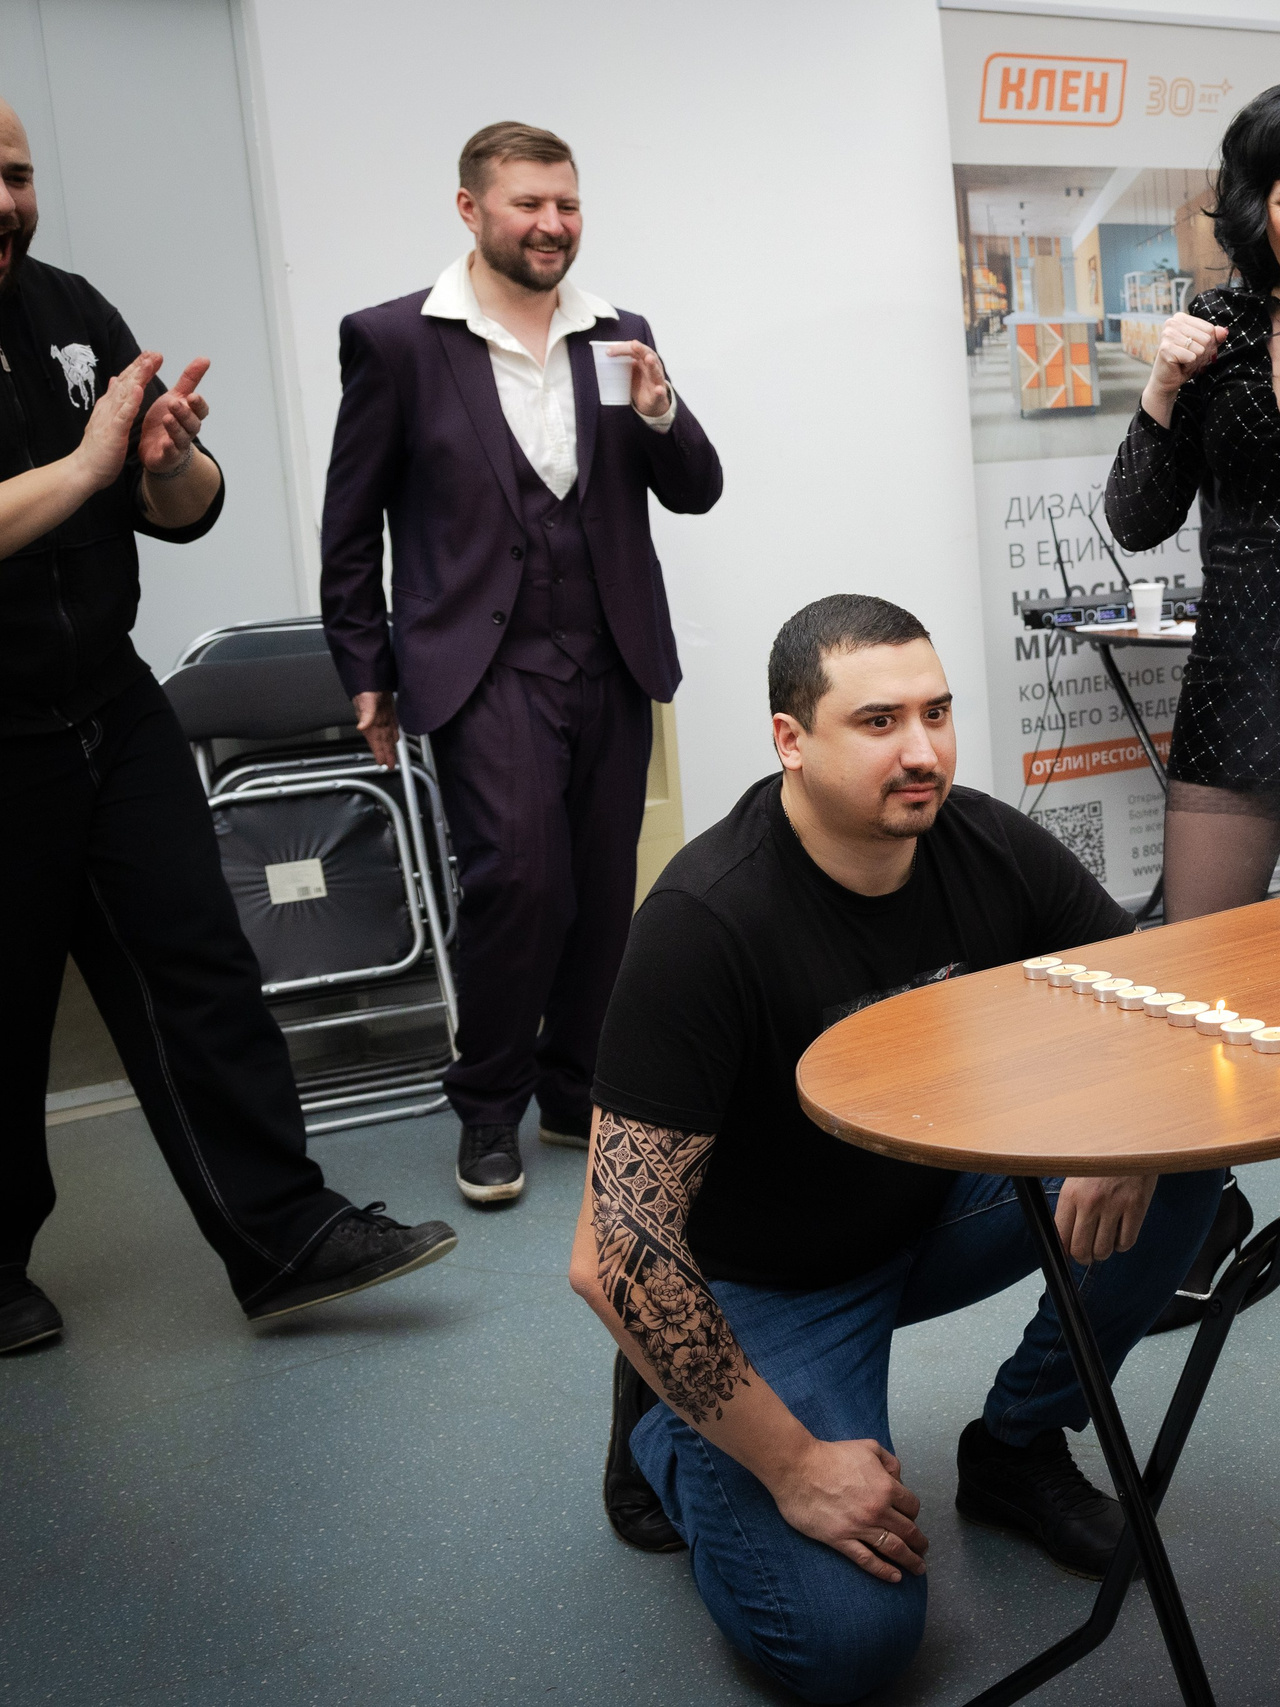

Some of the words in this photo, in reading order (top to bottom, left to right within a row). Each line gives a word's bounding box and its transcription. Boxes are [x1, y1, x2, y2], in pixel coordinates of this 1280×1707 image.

[998, 67, 1109, 113] КЛЕН
[1145, 76, 1195, 116] 30
[1010, 543, 1025, 569] В
[1021, 707, 1103, 735] ВАШЕГО
[1132, 846, 1139, 859] 8
